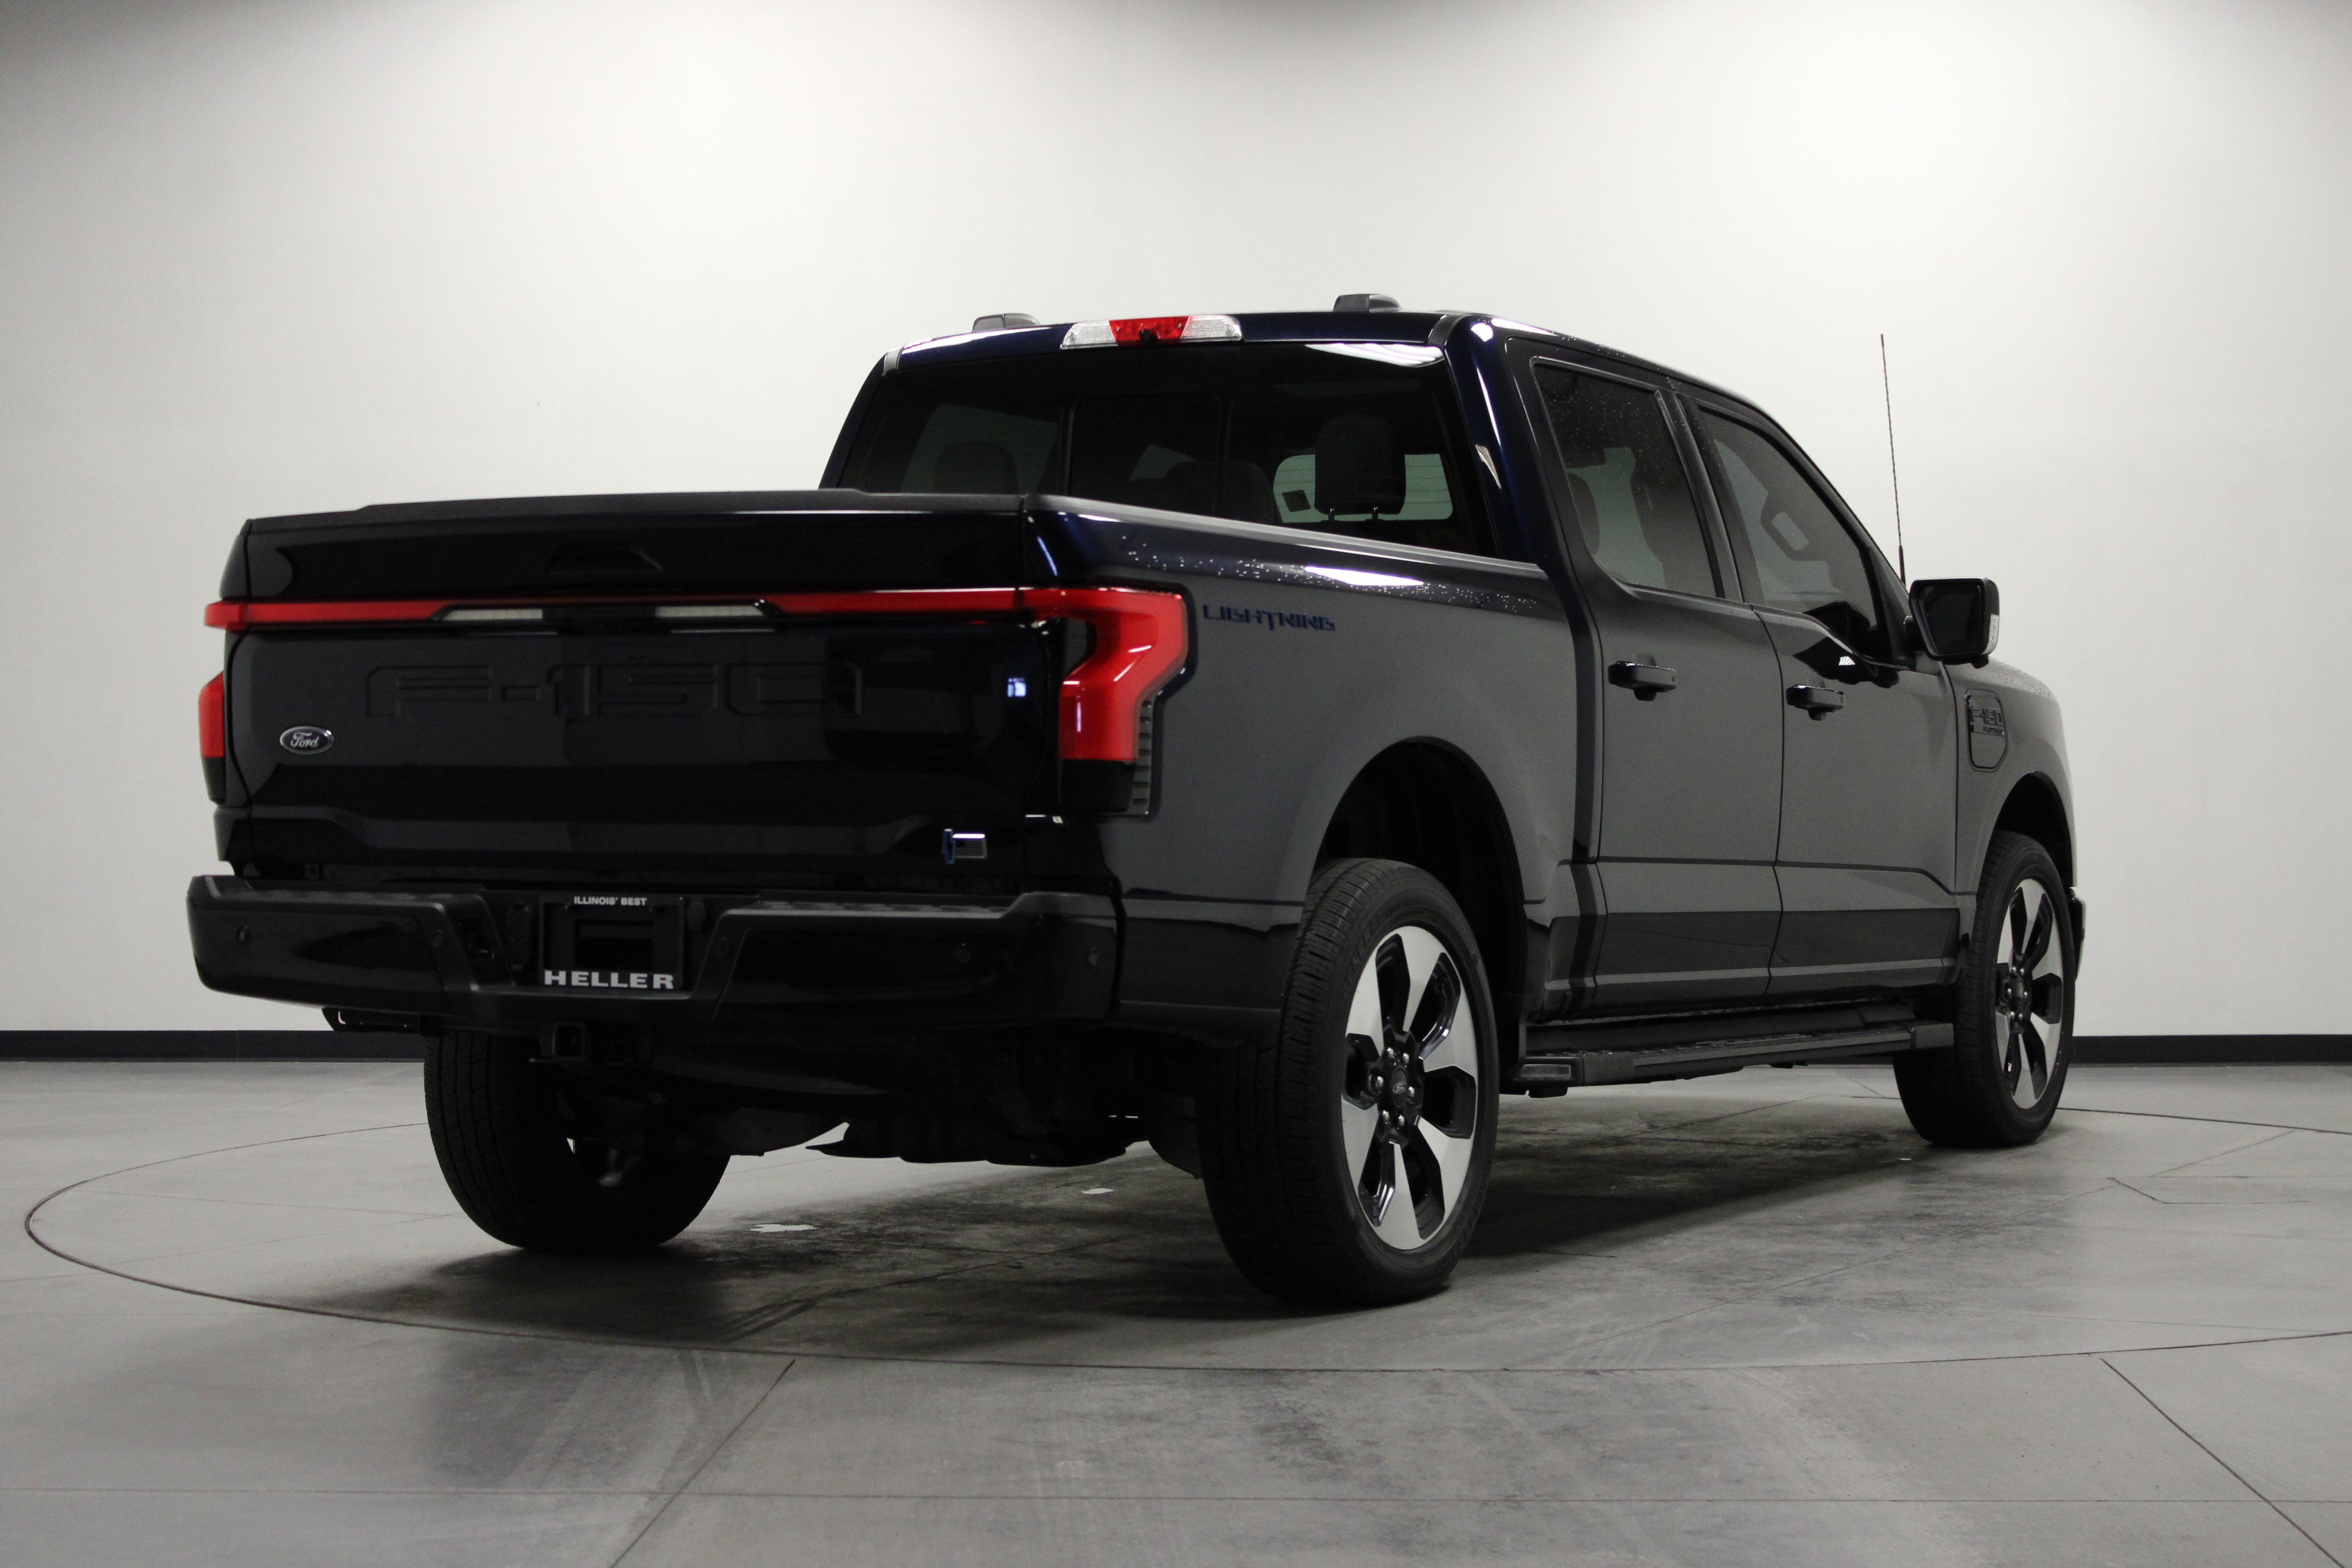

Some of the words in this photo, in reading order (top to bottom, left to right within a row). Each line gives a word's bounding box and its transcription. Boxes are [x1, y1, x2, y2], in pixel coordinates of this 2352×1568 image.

[1203, 604, 1335, 631] LIGHTNING
[366, 664, 863, 716] F-150
[290, 731, 319, 748] Ford
[573, 896, 618, 906] ILLINOIS'
[620, 897, 647, 906] BEST
[544, 970, 674, 989] HELLER
